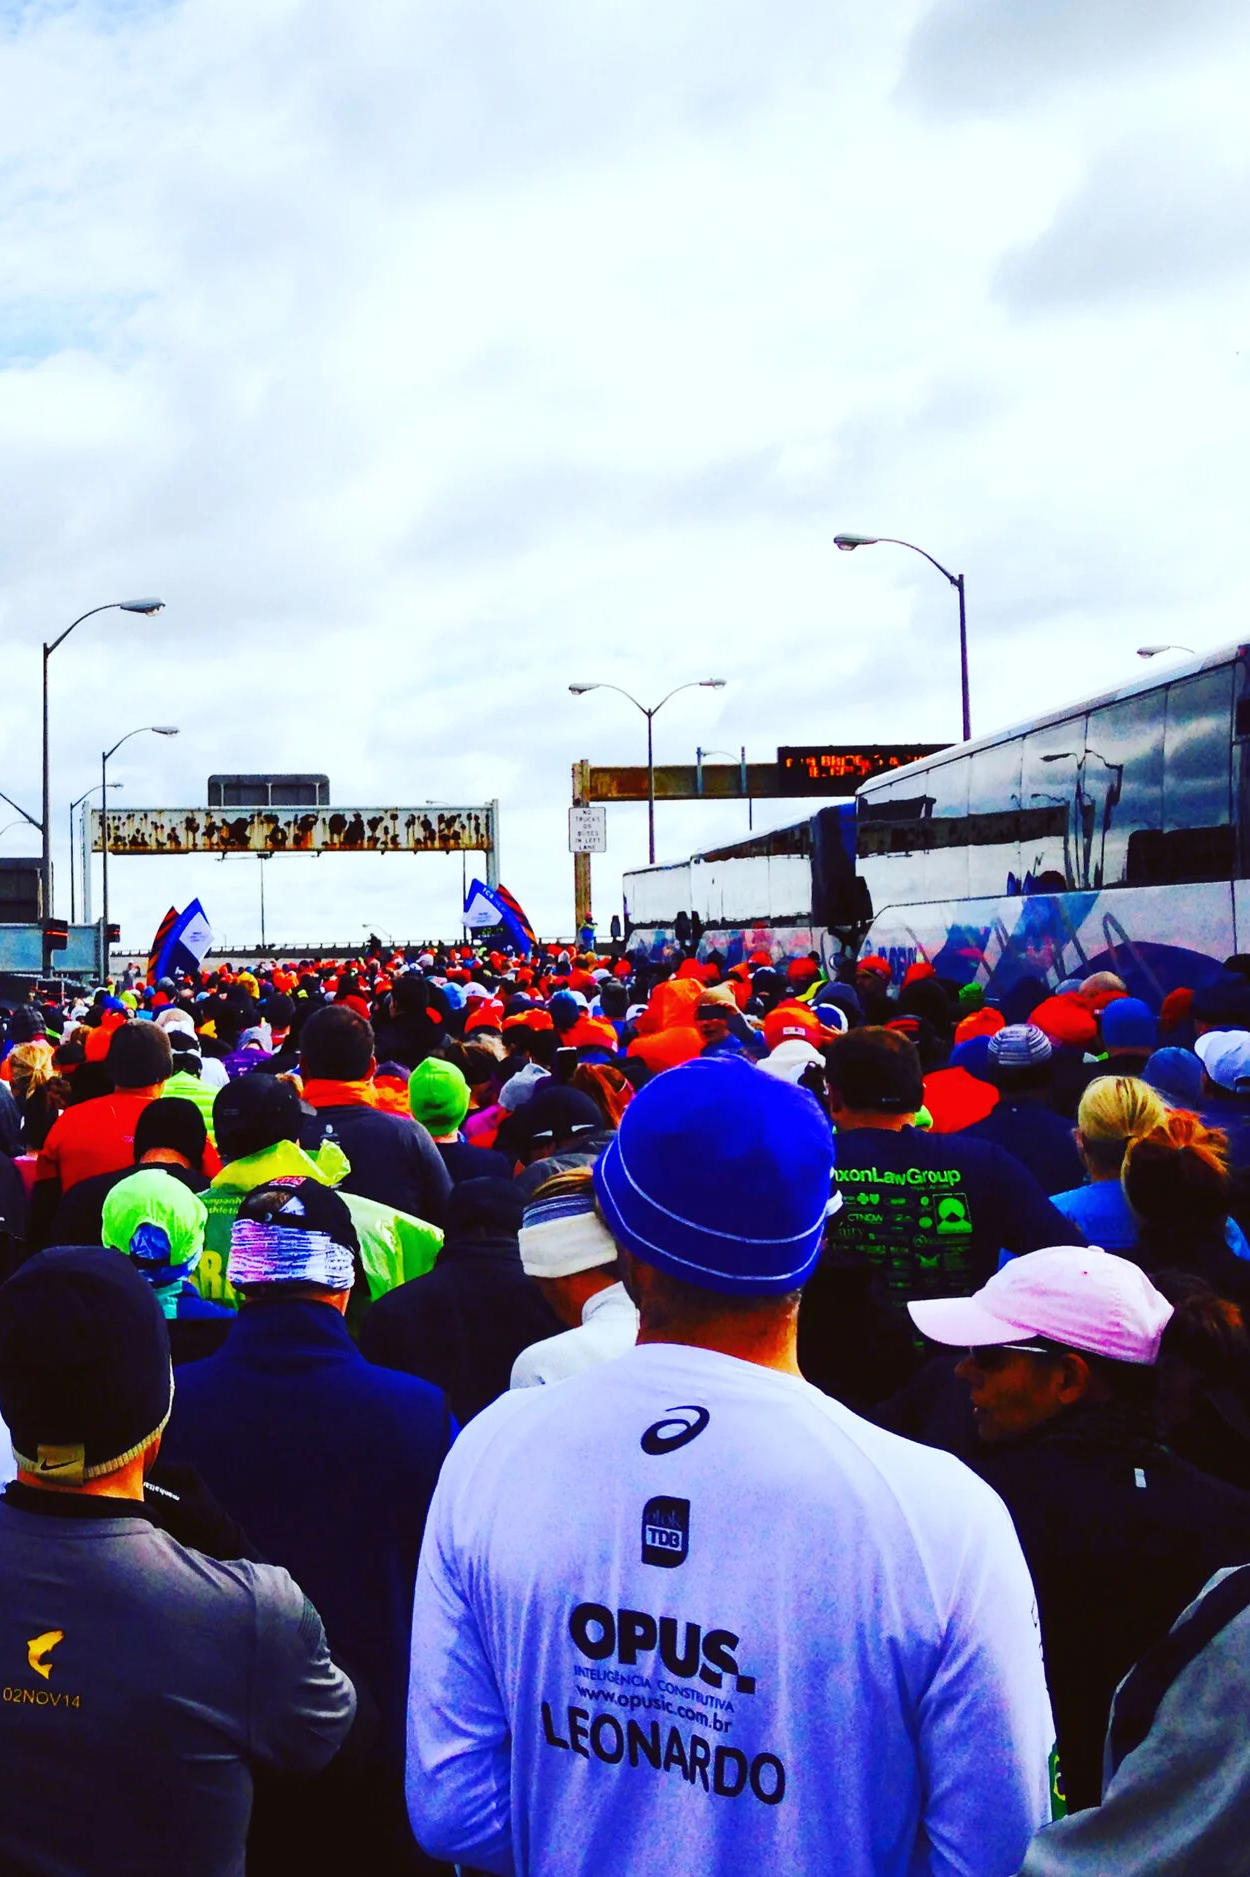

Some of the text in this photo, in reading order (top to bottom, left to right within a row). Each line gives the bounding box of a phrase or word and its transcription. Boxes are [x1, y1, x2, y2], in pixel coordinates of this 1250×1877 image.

[143, 1481, 181, 1501] manhatta
[647, 1527, 680, 1548] TDB
[2, 1686, 81, 1709] 02NOV14
[575, 1684, 732, 1734] www.opusic.com.br
[656, 1679, 736, 1714] CONSTRUTIVA
[540, 1700, 786, 1806] LEONARDO
